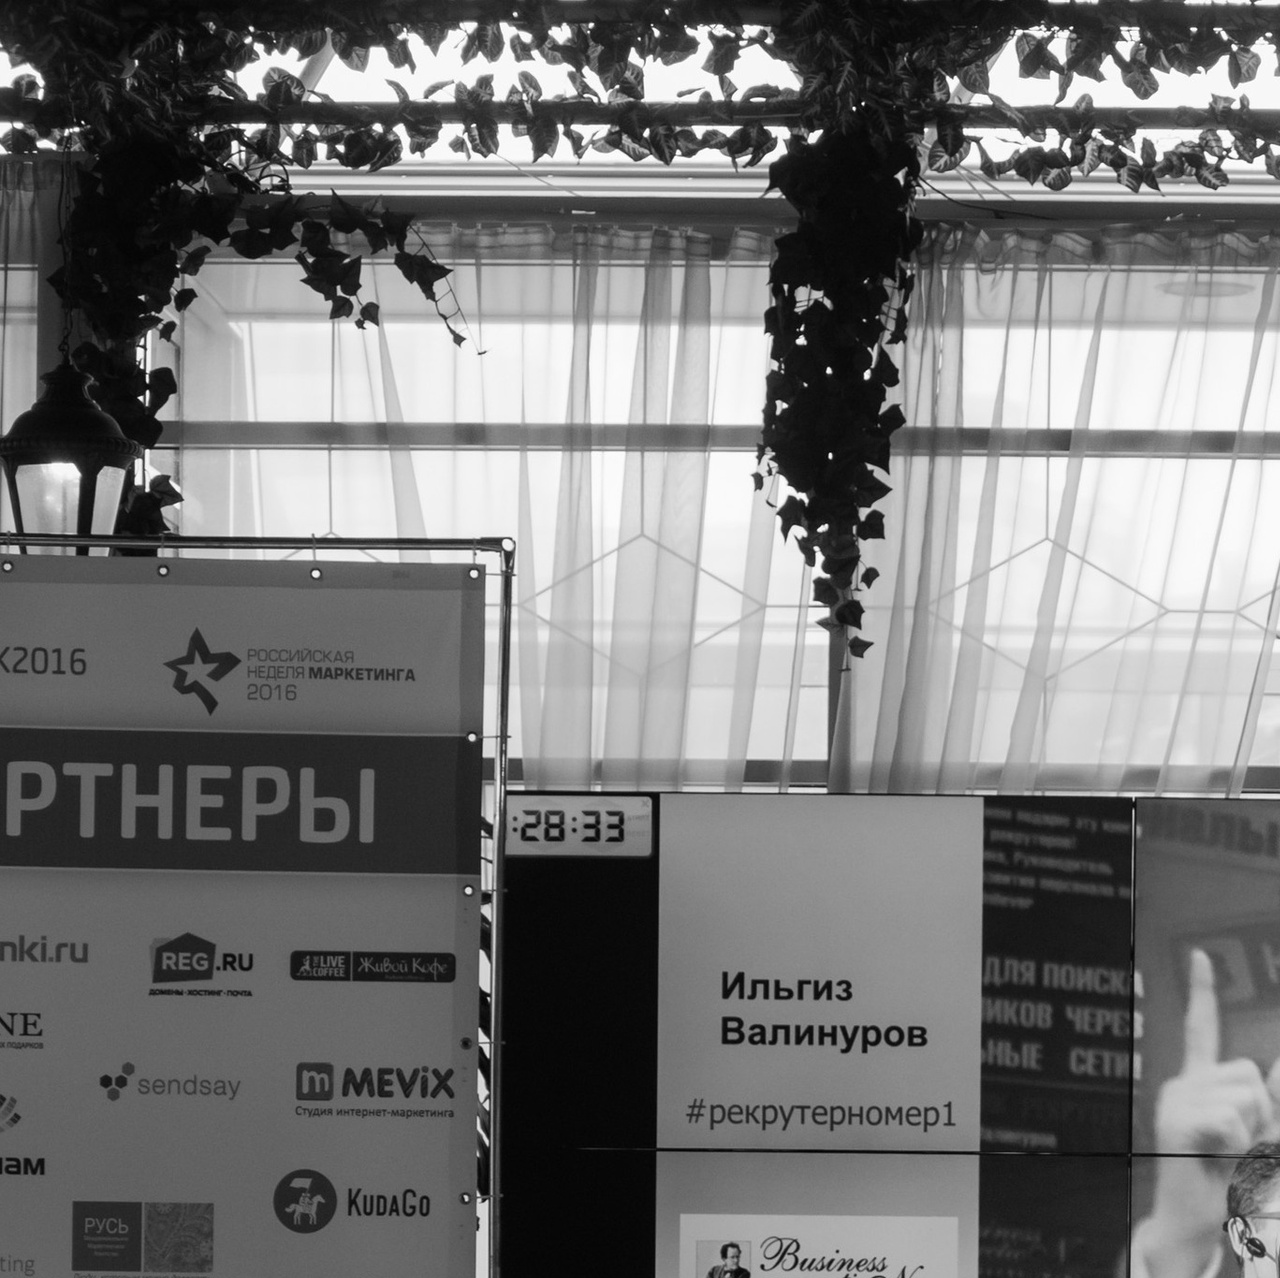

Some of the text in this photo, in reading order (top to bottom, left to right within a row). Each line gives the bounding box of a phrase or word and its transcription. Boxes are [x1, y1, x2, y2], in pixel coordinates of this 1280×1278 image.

[247, 647, 354, 664] РОССИЙСКАЯ
[247, 664, 415, 682] НЕДЕЛЯ МАРКЕТИНГА
[247, 683, 297, 701] 2016
[313, 967, 346, 977] COFFEE
[320, 956, 346, 967] LIVE
[358, 957, 448, 981] Живой Кофе
[984, 956, 1036, 986] ДЛЯ
[722, 971, 853, 1001] Ильгиз
[721, 1017, 929, 1054] Валинуров
[138, 1075, 241, 1101] sendsay
[295, 1106, 456, 1119] Студия интернет-маркетинга
[686, 1098, 957, 1133] #рекрутерномер1
[85, 1217, 129, 1234] РУСЬ
[760, 1236, 889, 1273] Business
